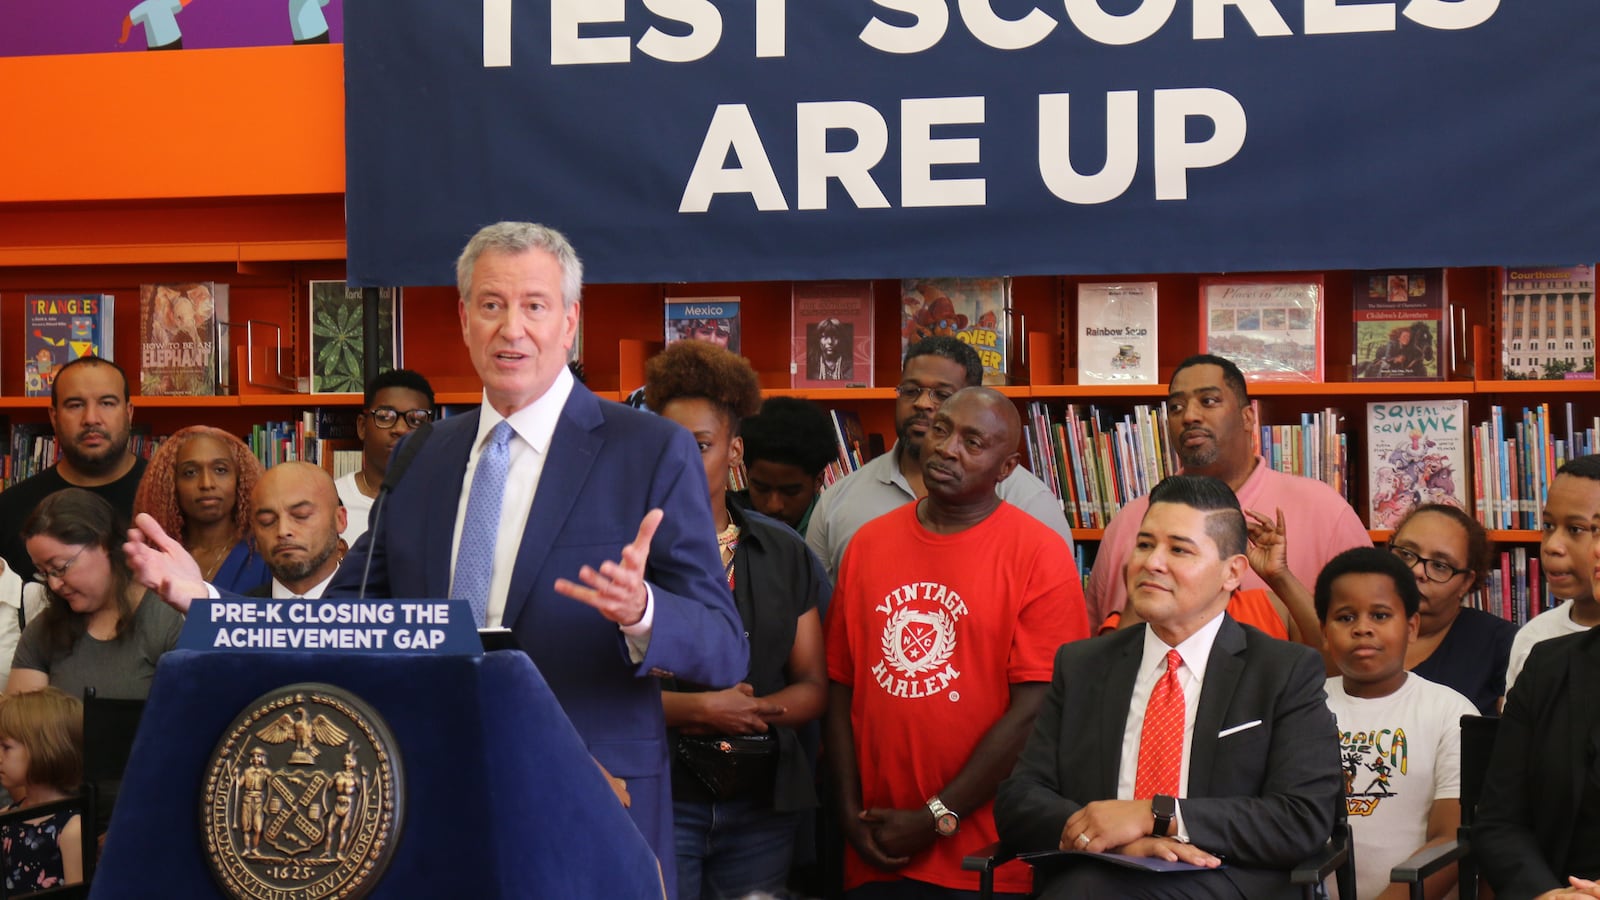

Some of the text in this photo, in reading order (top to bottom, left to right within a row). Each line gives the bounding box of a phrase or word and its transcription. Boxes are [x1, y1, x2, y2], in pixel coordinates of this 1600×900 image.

[678, 87, 1247, 213] ARE UP
[1510, 271, 1572, 280] Courthouse
[31, 299, 98, 315] TRIANGLES
[684, 305, 723, 316] Mexico
[1086, 327, 1123, 336] Rainbow
[143, 341, 212, 350] HOW TO BE AN
[142, 349, 209, 369] ELEPHANT
[1373, 404, 1439, 420] SQUEAL
[1373, 414, 1457, 434] SQUAWK
[875, 582, 969, 622] VINTAGE
[210, 603, 449, 624] PRE-K CLOSING THE
[213, 628, 446, 649] ACHIEVEMENT GAP
[871, 659, 960, 698] HARLEM
[1338, 727, 1408, 776] MAICA
[305, 872, 342, 900] NOVI
[344, 805, 378, 871] EBORACI
[273, 866, 312, 880] 1625
